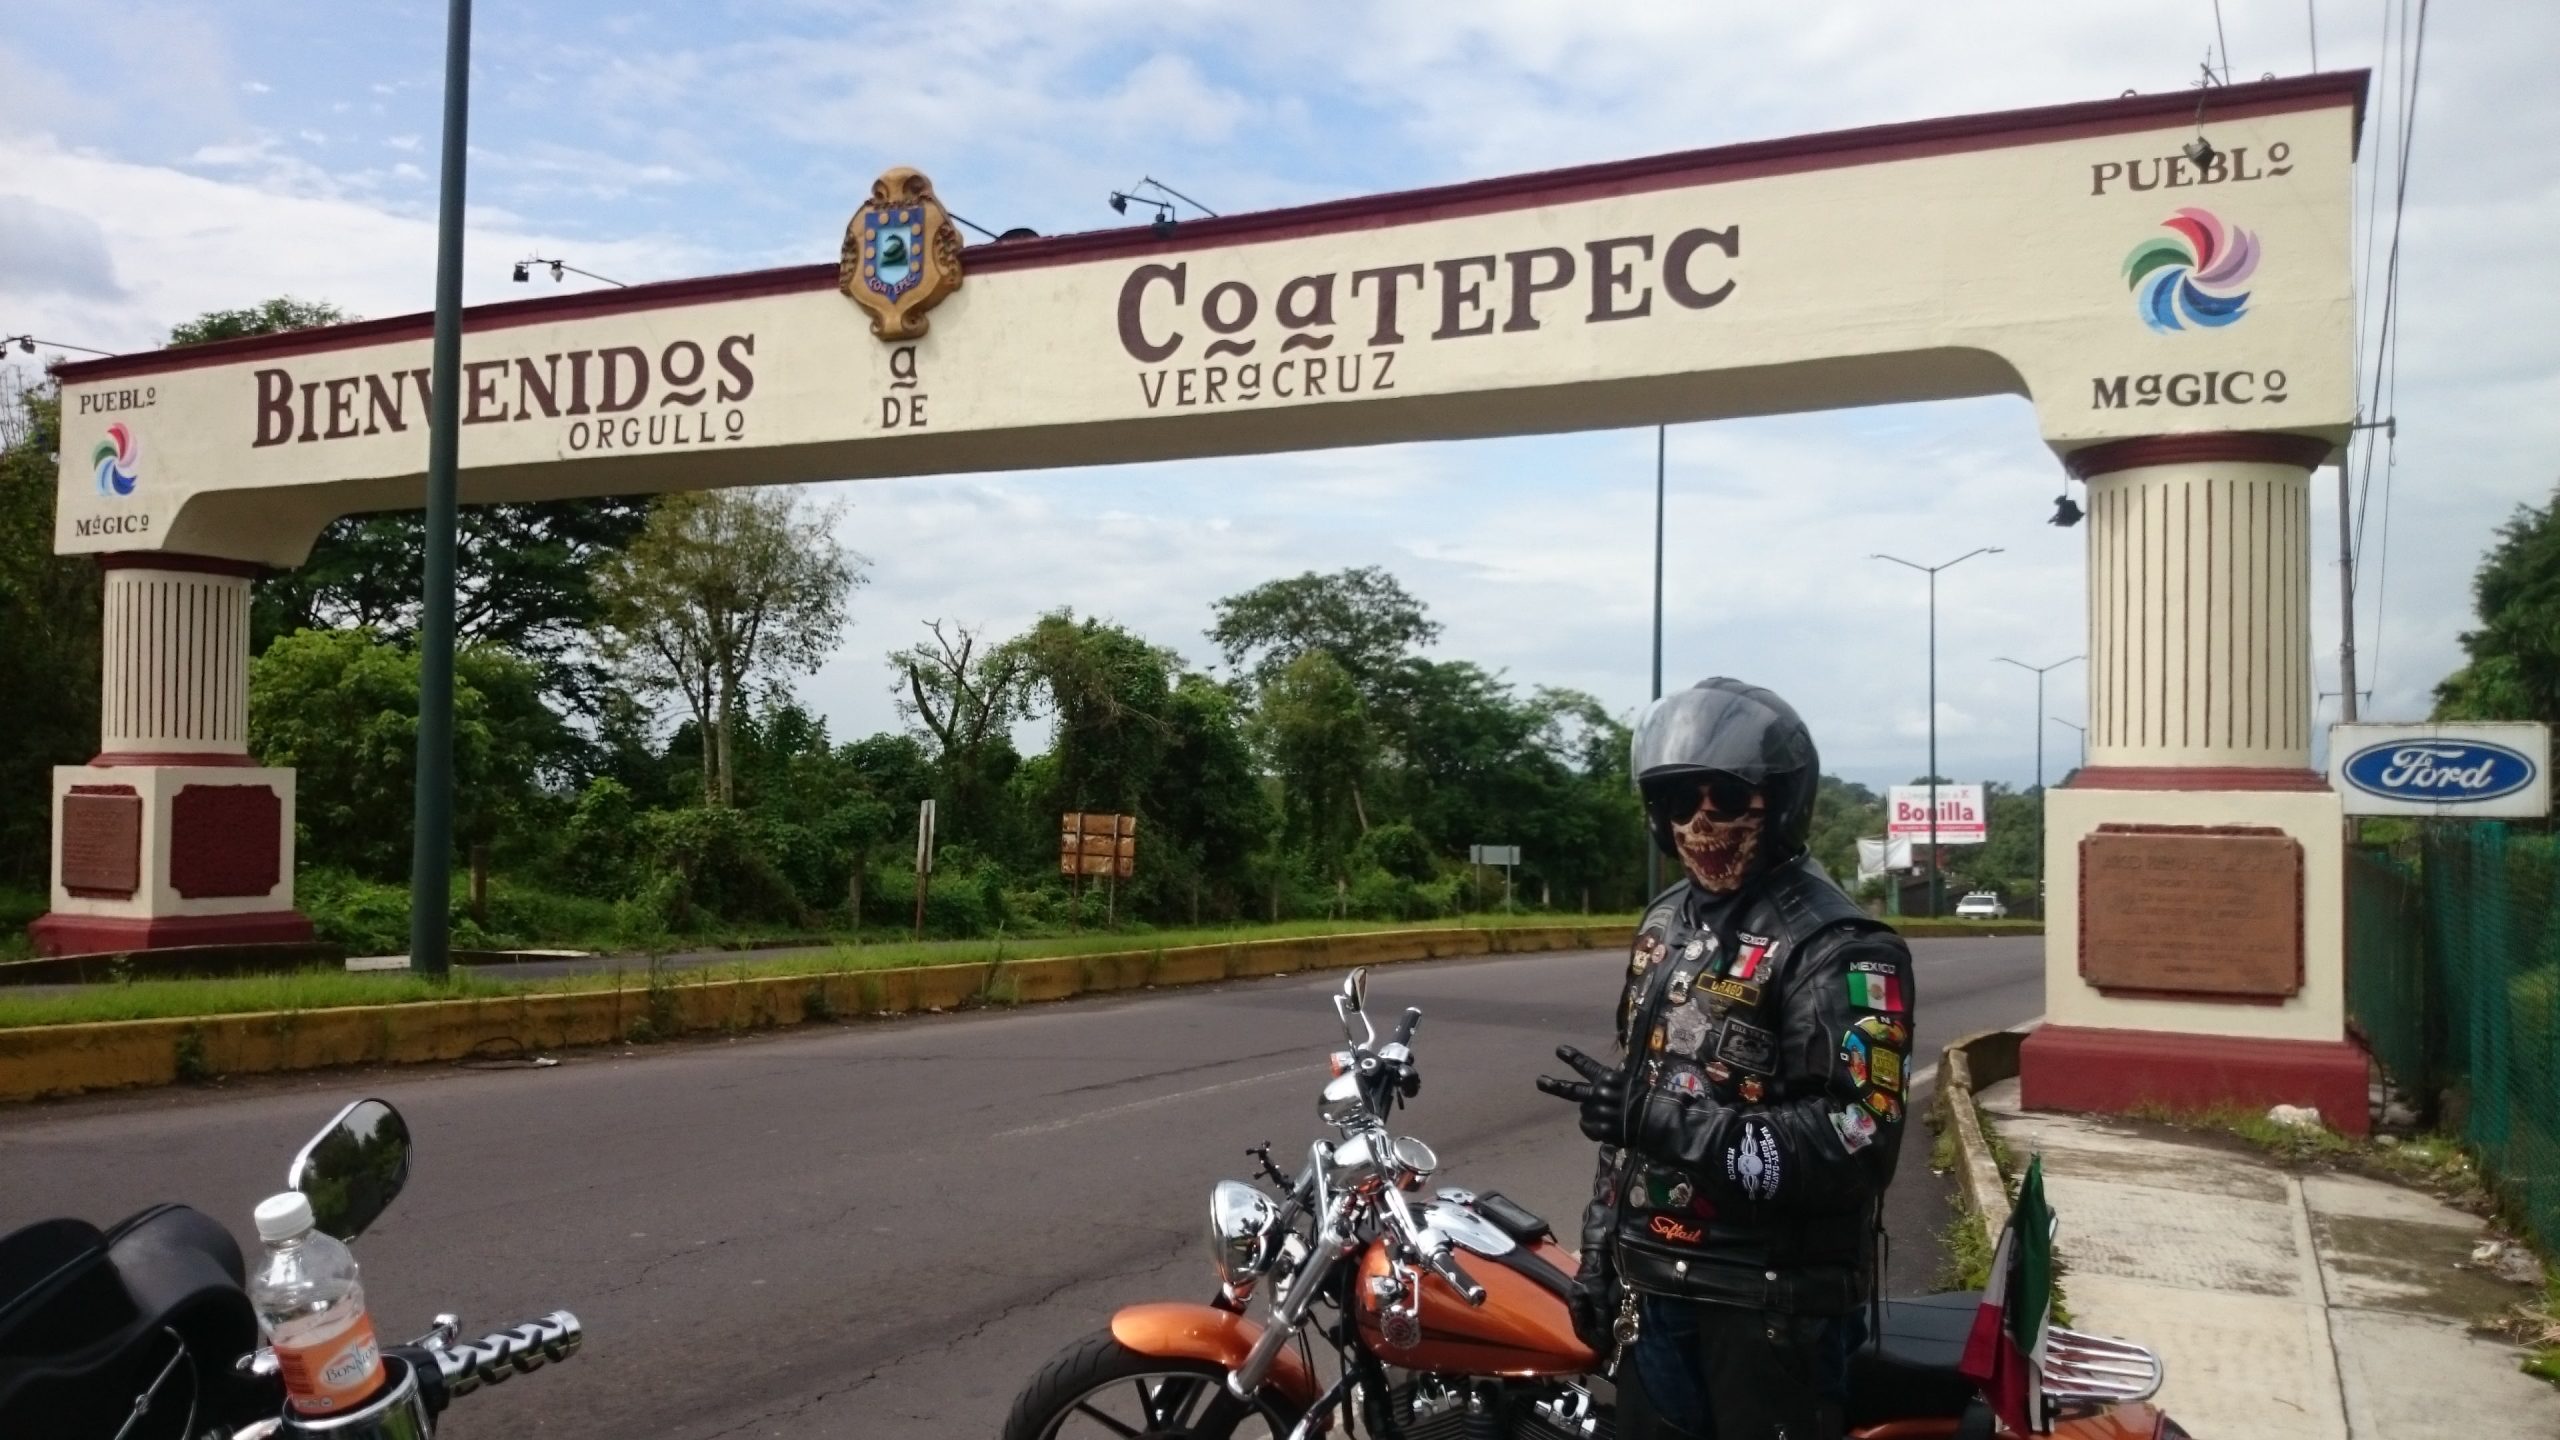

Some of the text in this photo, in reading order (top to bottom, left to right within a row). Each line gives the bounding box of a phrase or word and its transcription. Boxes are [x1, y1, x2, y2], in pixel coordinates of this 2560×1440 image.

[881, 393, 929, 429] DE
[2381, 747, 2495, 788] Ford
[1850, 961, 1896, 974] MEXICO
[1727, 1146, 1736, 1181] MEXICO
[1759, 1139, 1773, 1190] MONTERREY
[1650, 1215, 1702, 1243] Softail
